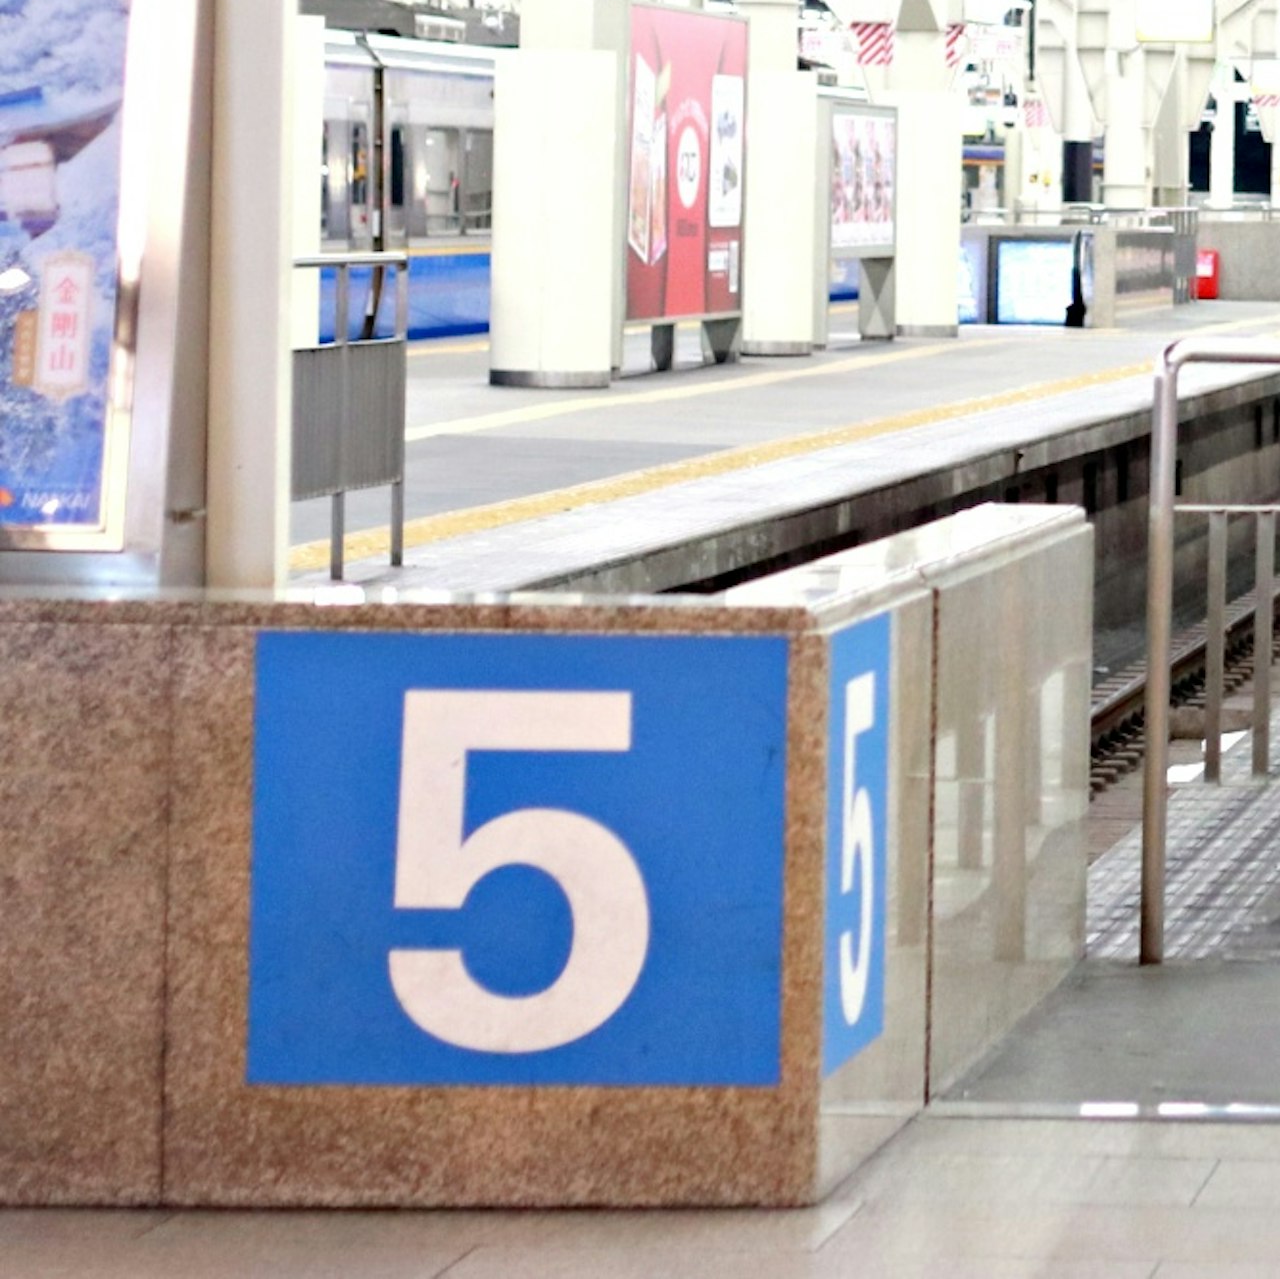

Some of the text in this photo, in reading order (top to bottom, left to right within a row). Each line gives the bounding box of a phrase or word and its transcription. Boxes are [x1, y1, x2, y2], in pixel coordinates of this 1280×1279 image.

[51, 276, 79, 371] 金剛山
[387, 689, 650, 1054] 5
[837, 671, 878, 1026] 5
